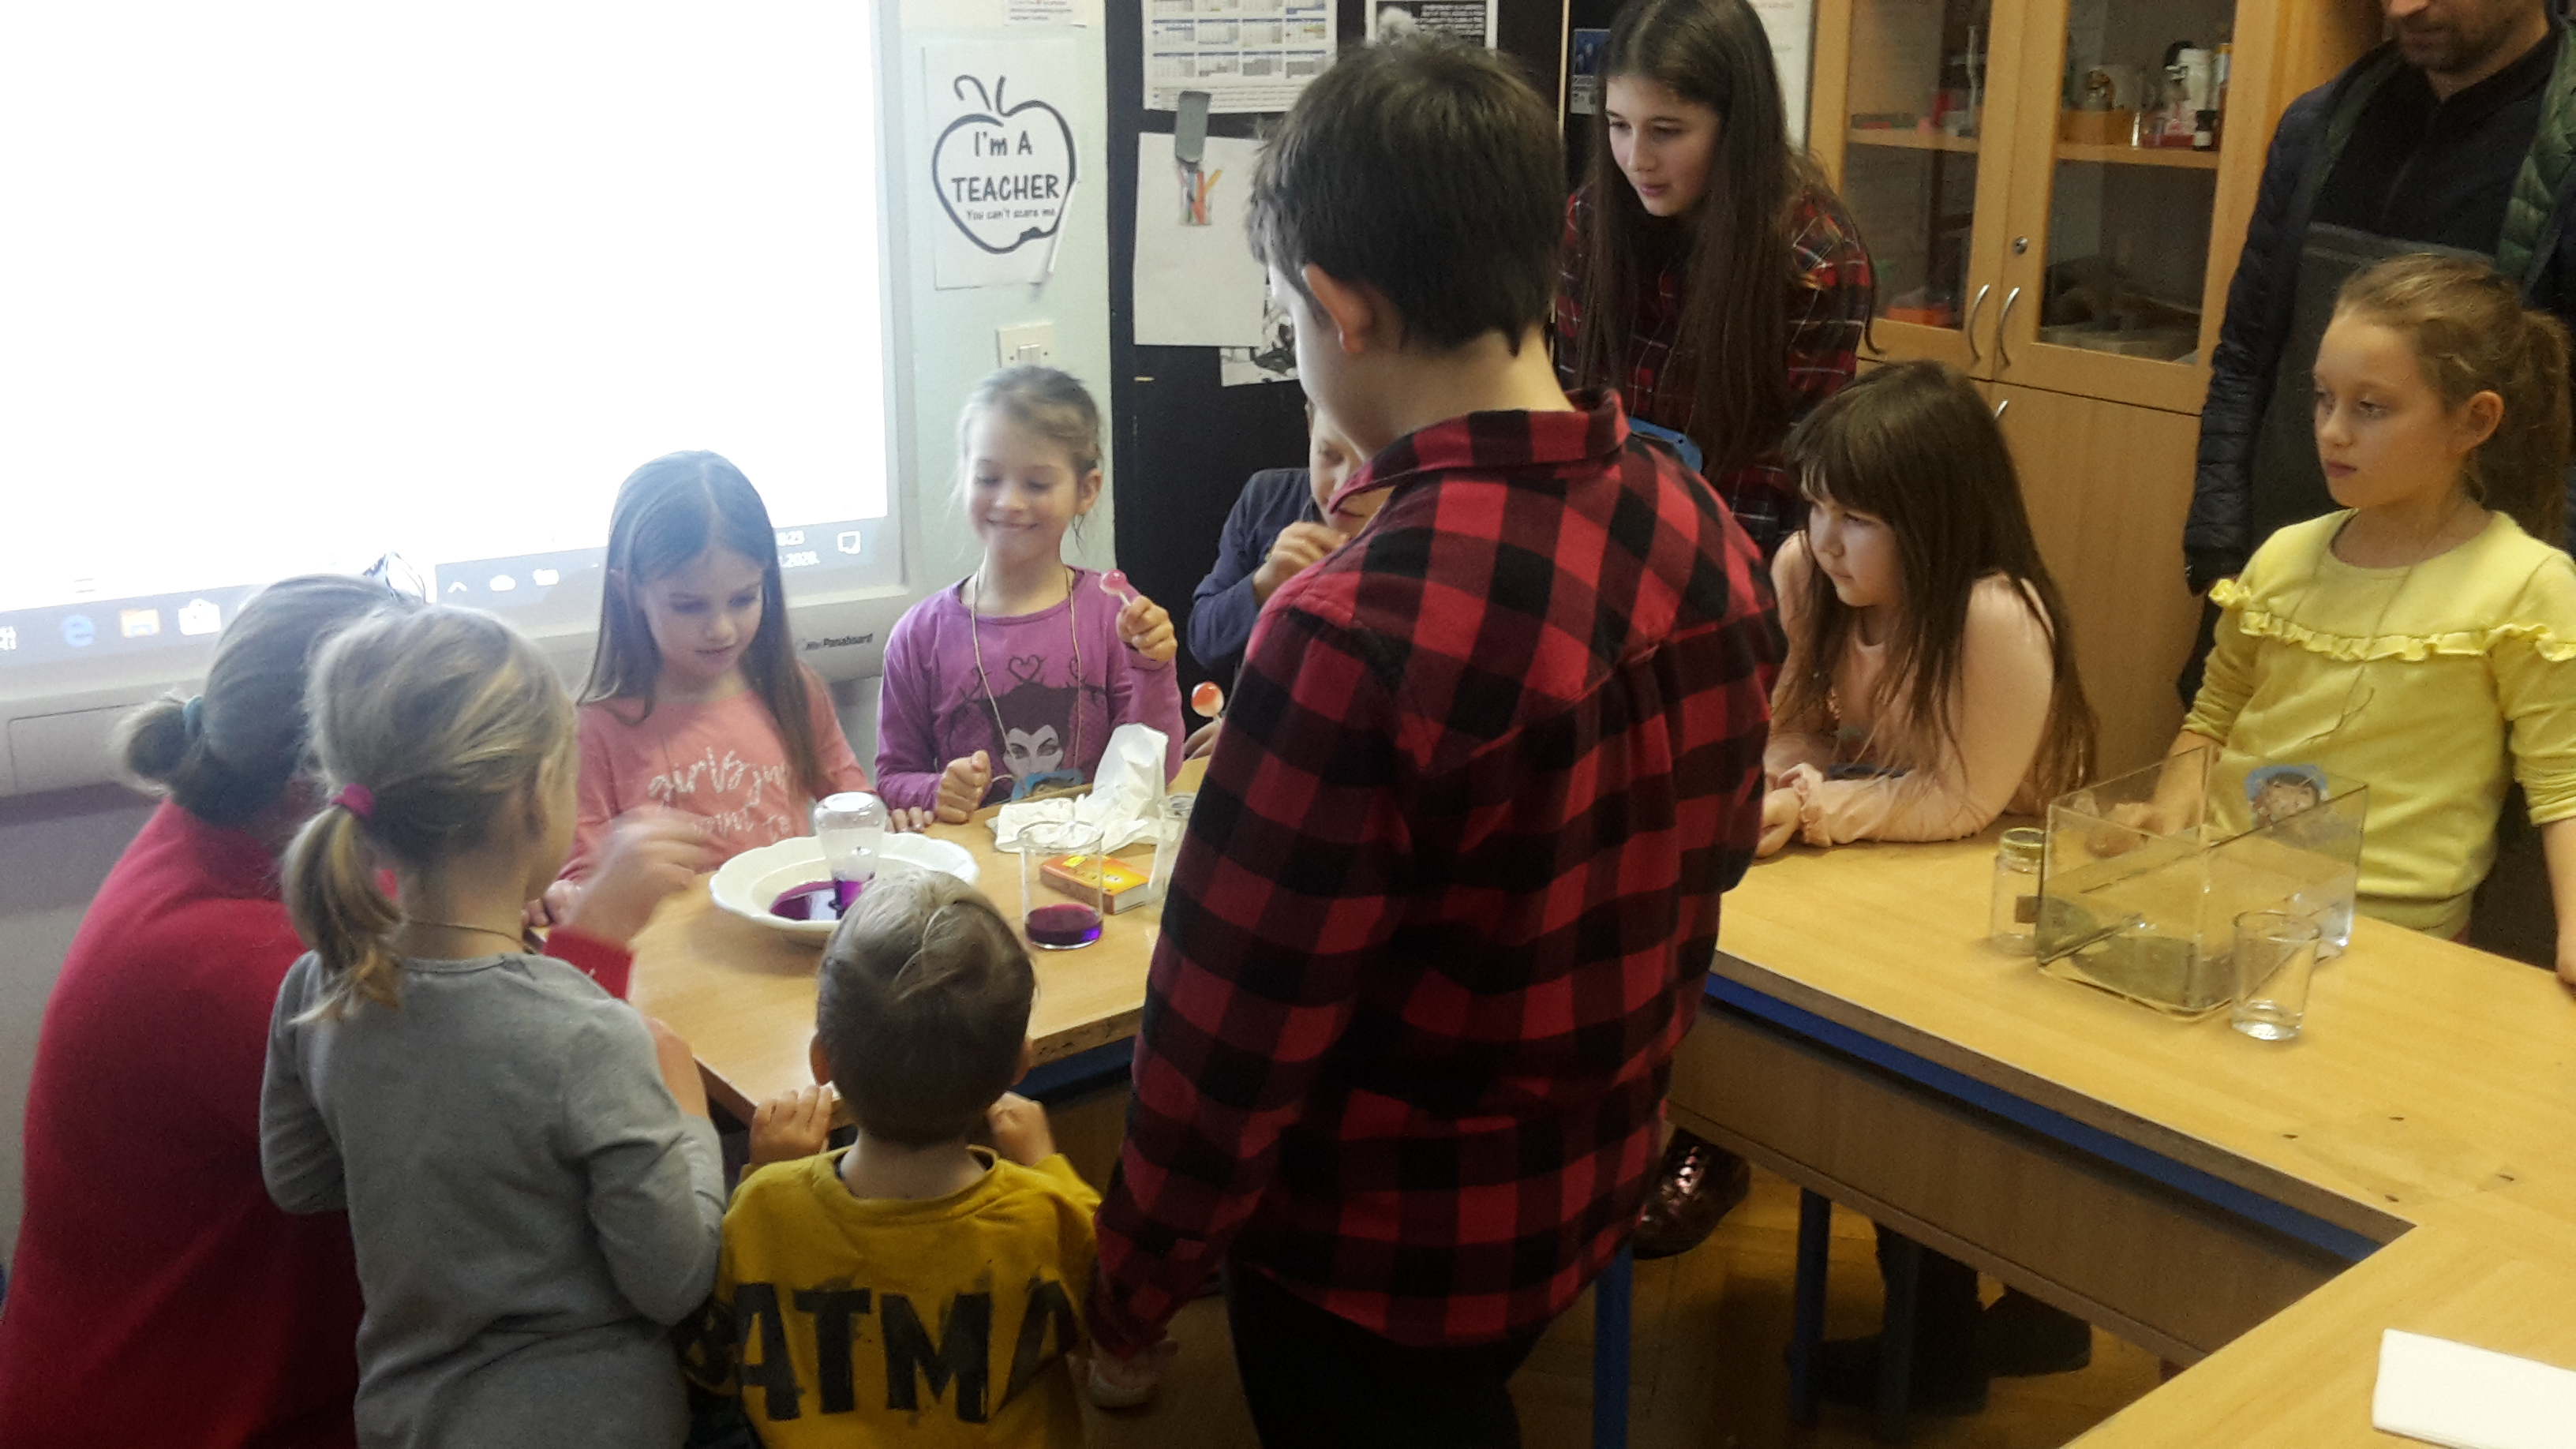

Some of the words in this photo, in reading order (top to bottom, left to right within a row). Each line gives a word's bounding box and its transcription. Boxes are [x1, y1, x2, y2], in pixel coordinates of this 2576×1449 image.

[975, 130, 1008, 157] I'm
[1017, 129, 1033, 155] A
[951, 174, 1060, 203] TEACHER
[967, 209, 984, 221] You
[987, 208, 1010, 220] can't
[1013, 208, 1039, 219] scare
[648, 746, 749, 803] girls
